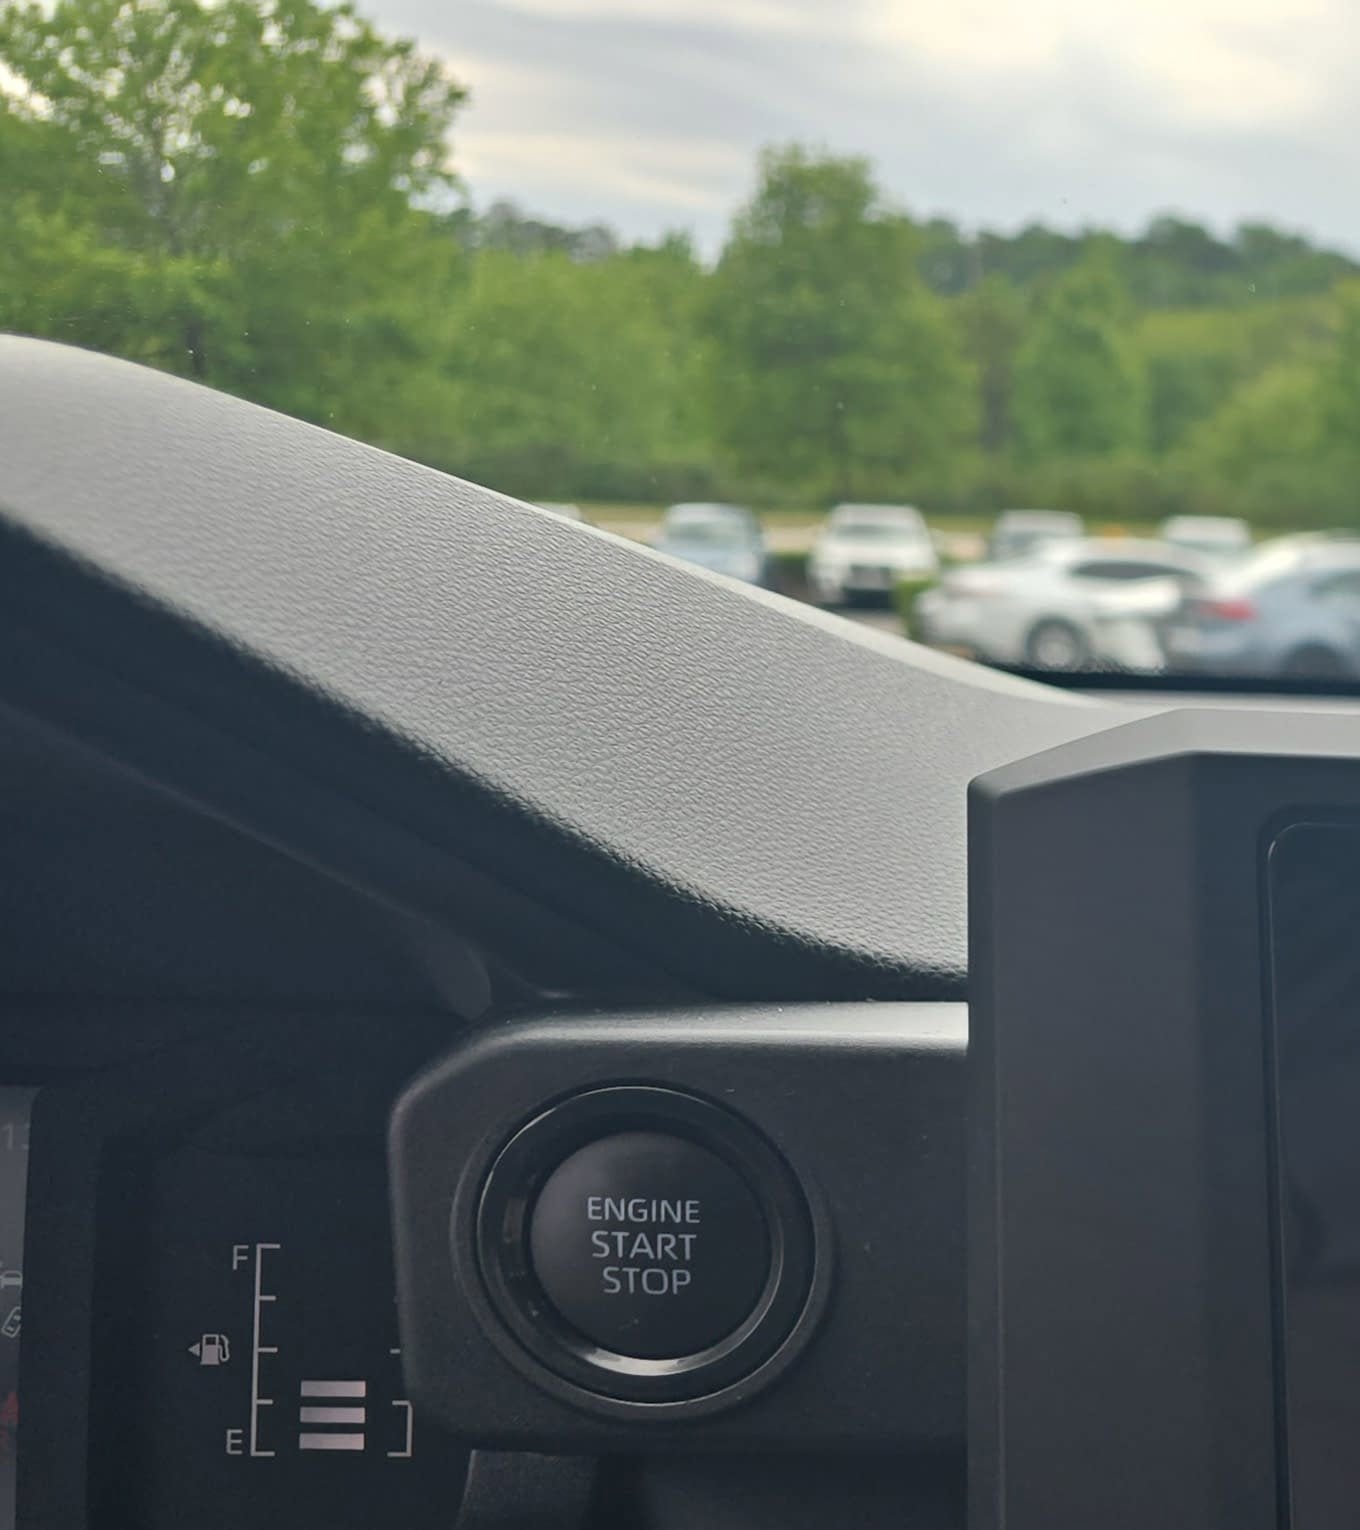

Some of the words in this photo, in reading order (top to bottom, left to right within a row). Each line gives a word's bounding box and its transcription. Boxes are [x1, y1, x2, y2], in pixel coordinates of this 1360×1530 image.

[587, 1196, 701, 1224] ENGINE
[232, 1244, 250, 1272] F
[591, 1229, 698, 1261] START
[602, 1266, 692, 1296] STOP
[226, 1429, 244, 1456] E
